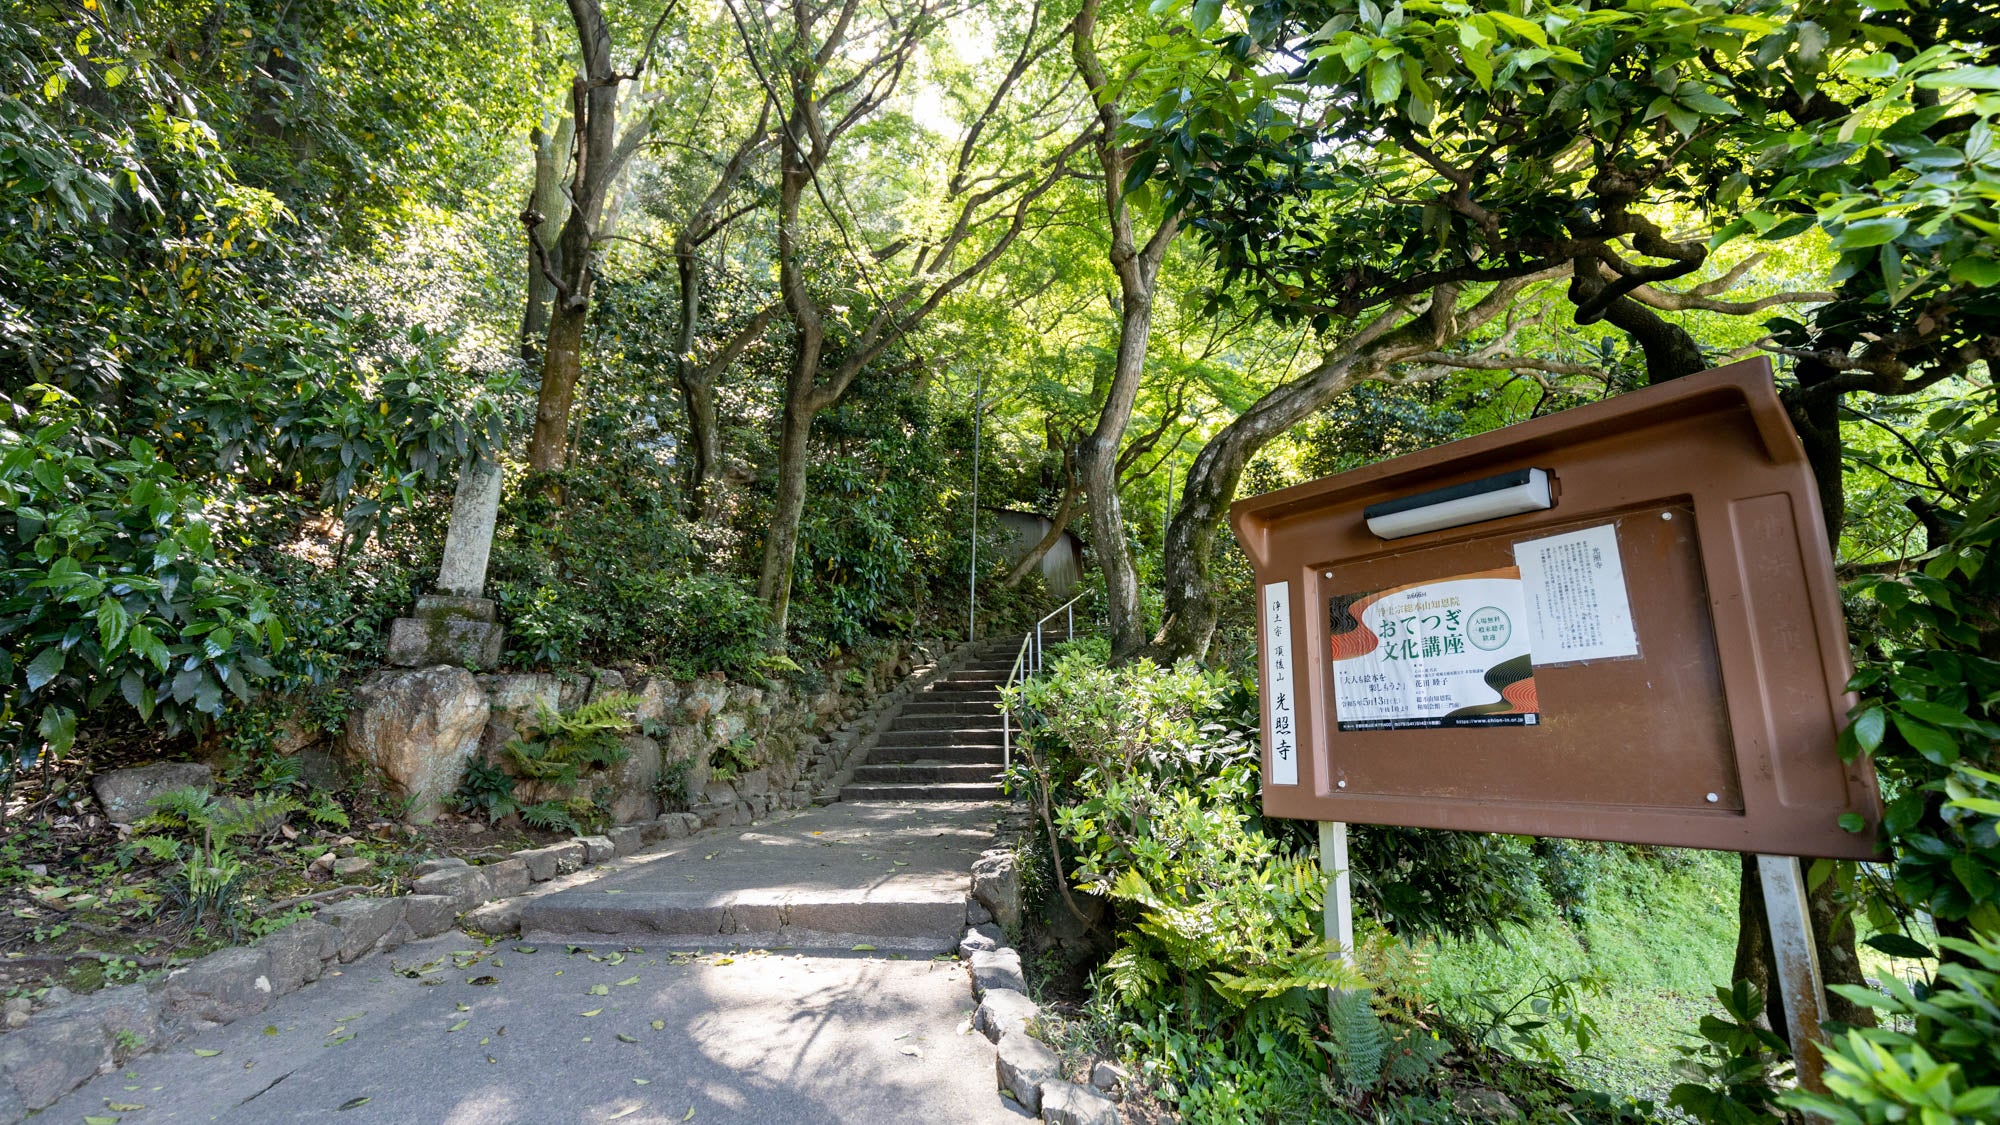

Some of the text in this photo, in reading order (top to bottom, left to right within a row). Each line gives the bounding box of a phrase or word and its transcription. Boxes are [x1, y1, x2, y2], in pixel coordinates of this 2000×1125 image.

[1379, 609, 1462, 639] おてつぎ
[1475, 615, 1501, 625] 入場無料
[1380, 634, 1465, 662] 文化講座
[1275, 692, 1292, 761] 光照寺
